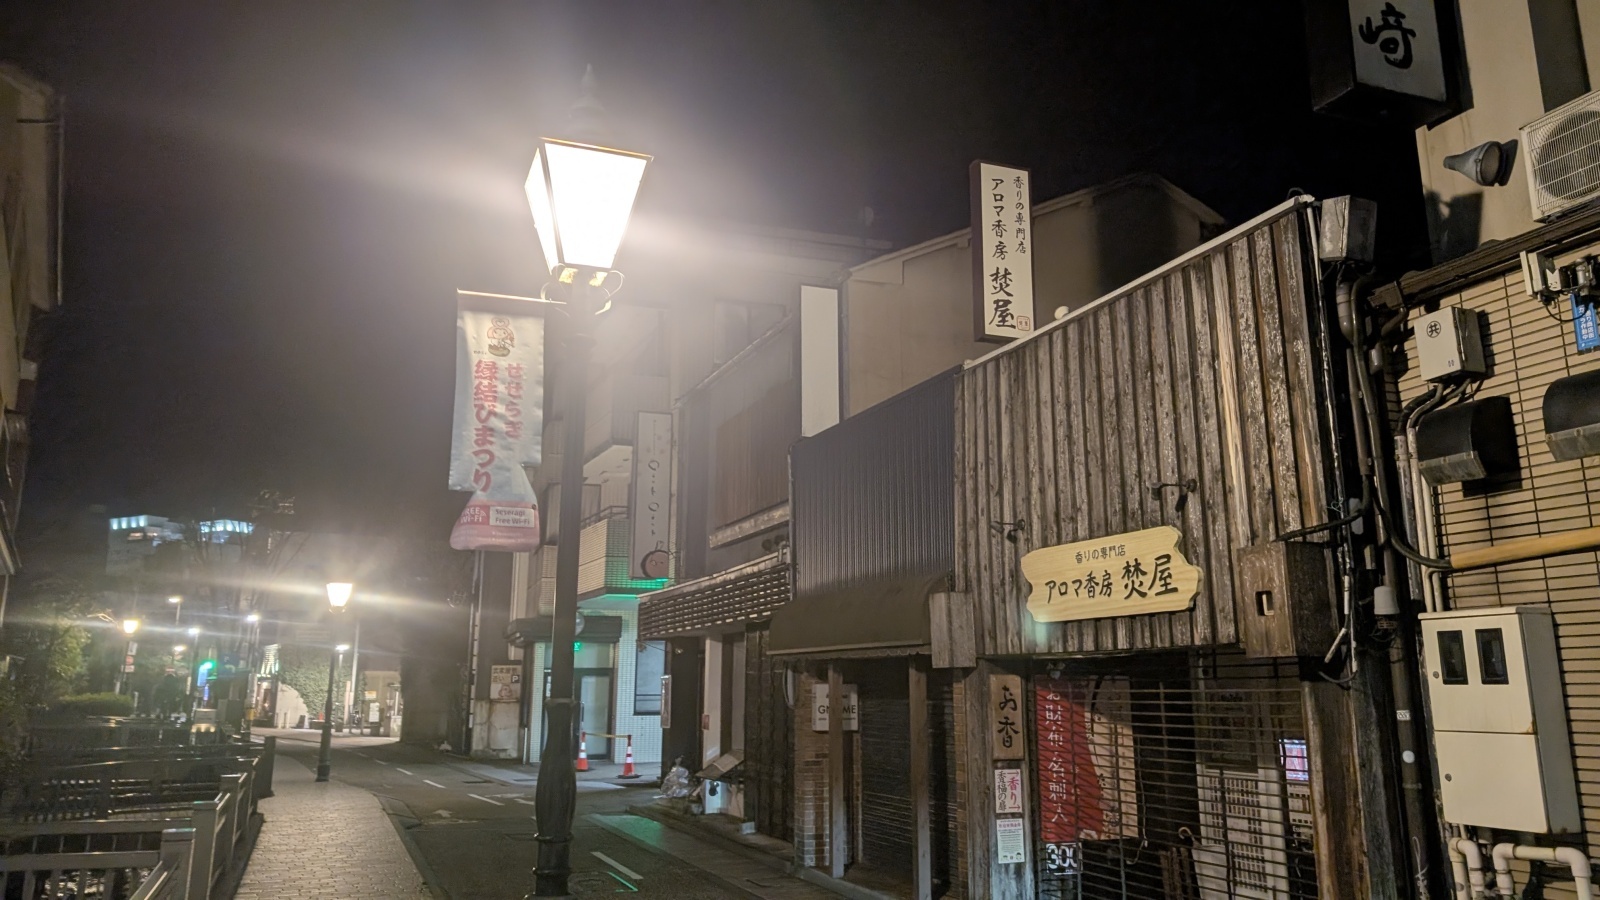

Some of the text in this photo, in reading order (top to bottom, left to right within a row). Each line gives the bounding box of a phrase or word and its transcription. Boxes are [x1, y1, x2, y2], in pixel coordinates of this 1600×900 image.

[1013, 175, 1027, 255] 香りの専門店
[988, 178, 1017, 330] アロマ香房 焚屋
[505, 363, 524, 439] せせらぎ
[472, 359, 498, 493] 縁結びまつり
[462, 506, 481, 516] REE
[495, 508, 526, 517] Seseragi
[495, 517, 530, 526] Free Wi-Fi
[1075, 544, 1126, 564] 香りの専門店
[1044, 553, 1179, 604] アロマ香房 焚屋
[818, 704, 857, 714] GME
[997, 685, 1020, 749] お香
[1007, 776, 1020, 806] 香り
